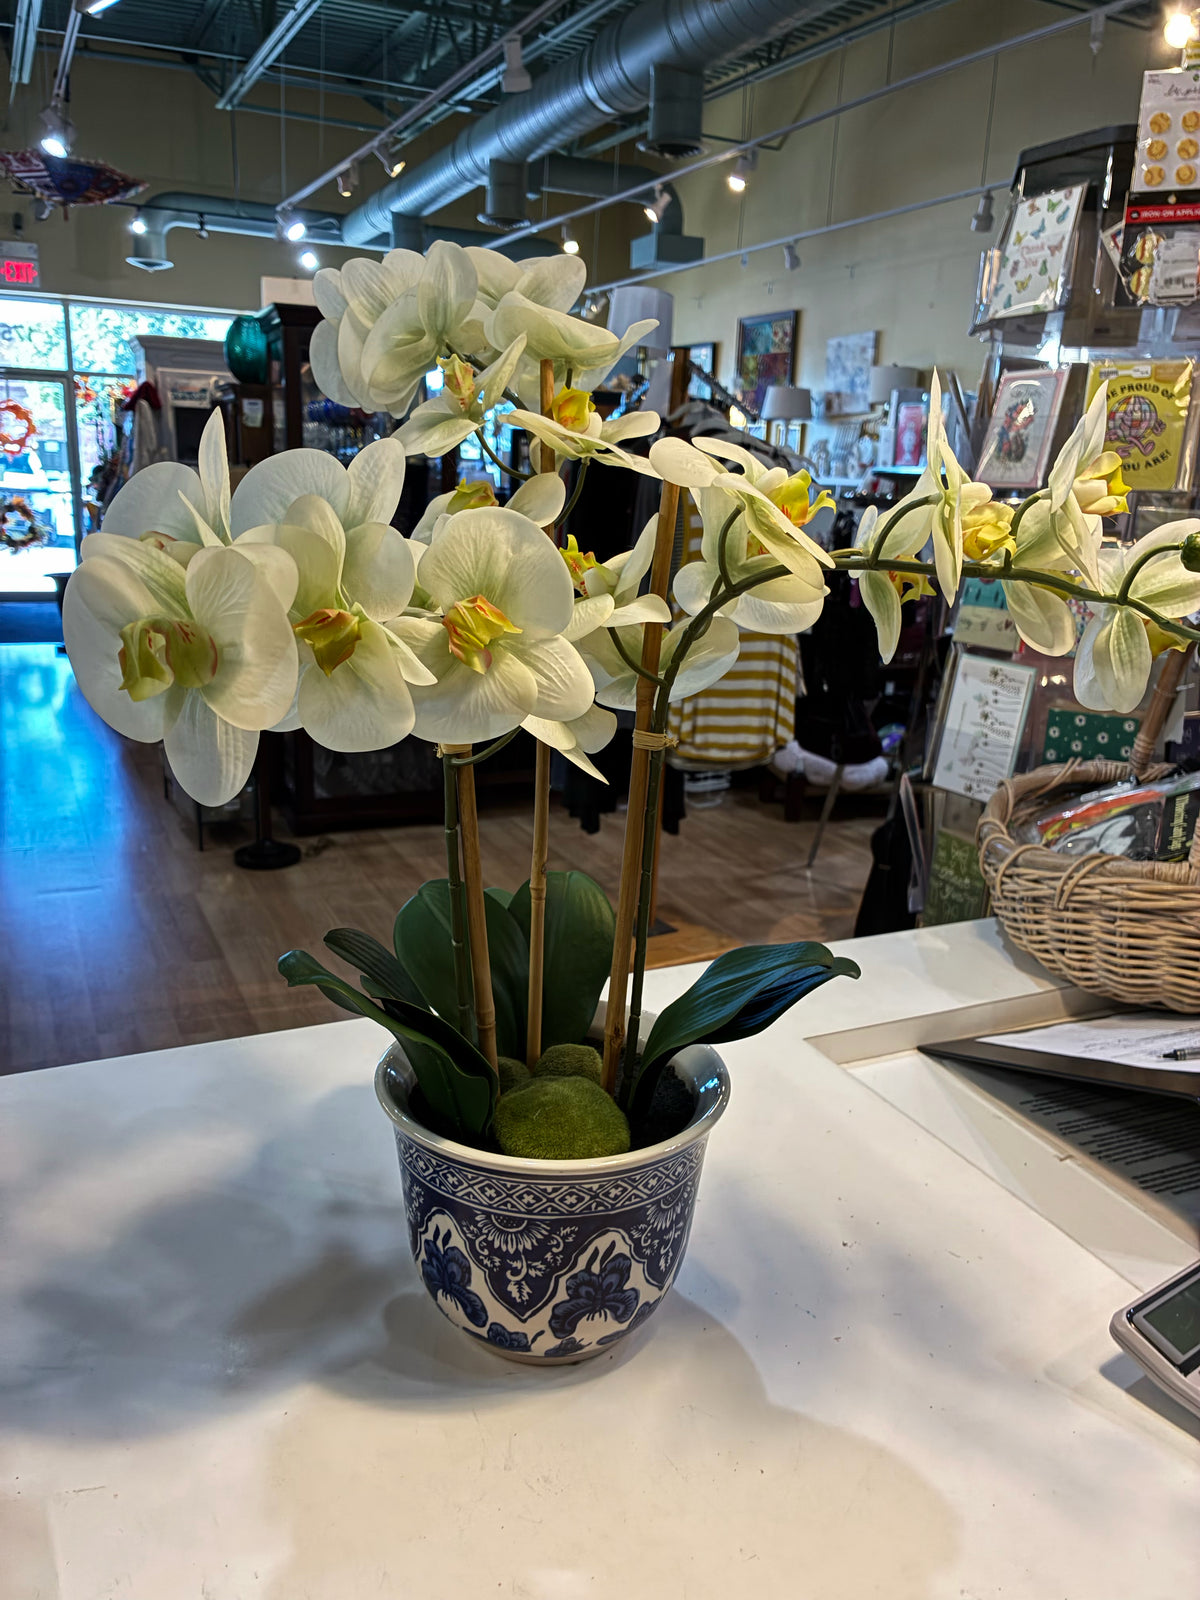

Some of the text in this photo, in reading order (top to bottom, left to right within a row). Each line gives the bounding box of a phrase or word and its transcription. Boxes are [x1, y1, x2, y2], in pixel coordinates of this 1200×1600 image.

[5, 260, 34, 284] EXIT
[1120, 382, 1159, 395] PROUD
[1121, 449, 1172, 472] OU ARE!
